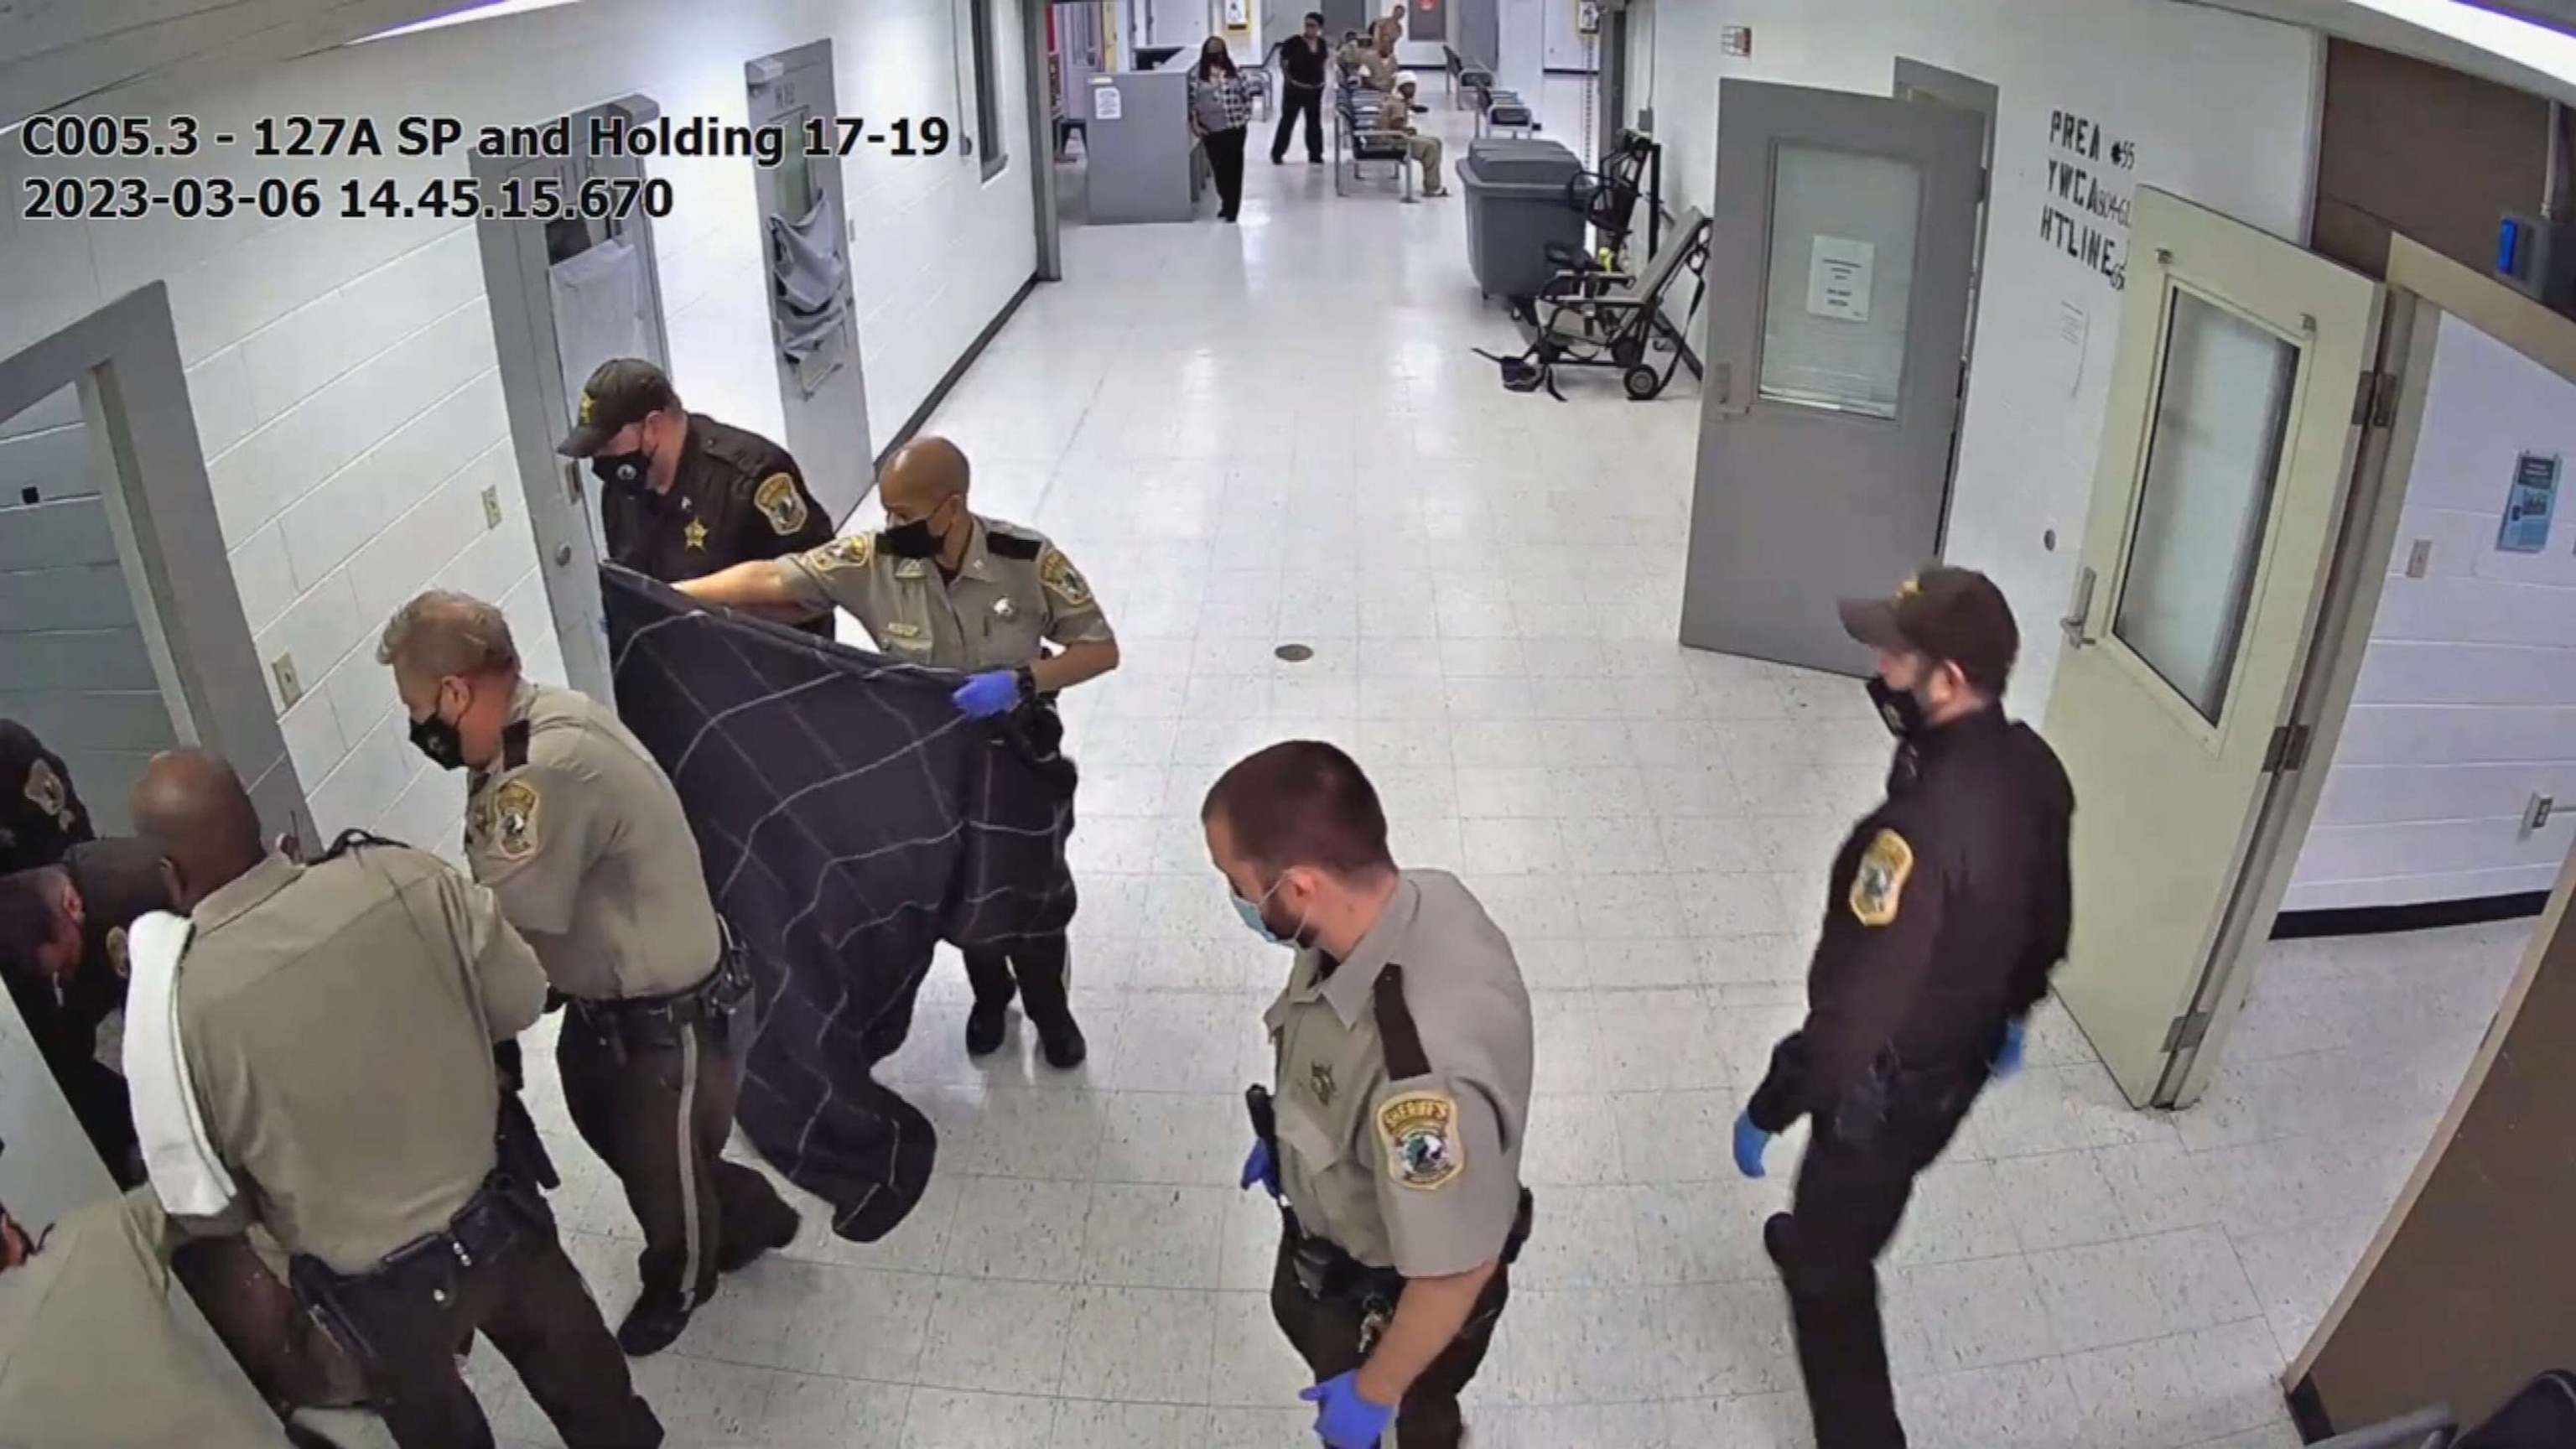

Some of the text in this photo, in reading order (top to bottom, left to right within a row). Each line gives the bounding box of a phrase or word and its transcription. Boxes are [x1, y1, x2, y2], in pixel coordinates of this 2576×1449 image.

[2049, 110, 2101, 161] PREA
[2048, 158, 2097, 211] YWCA
[2040, 205, 2116, 278] HTLINE
